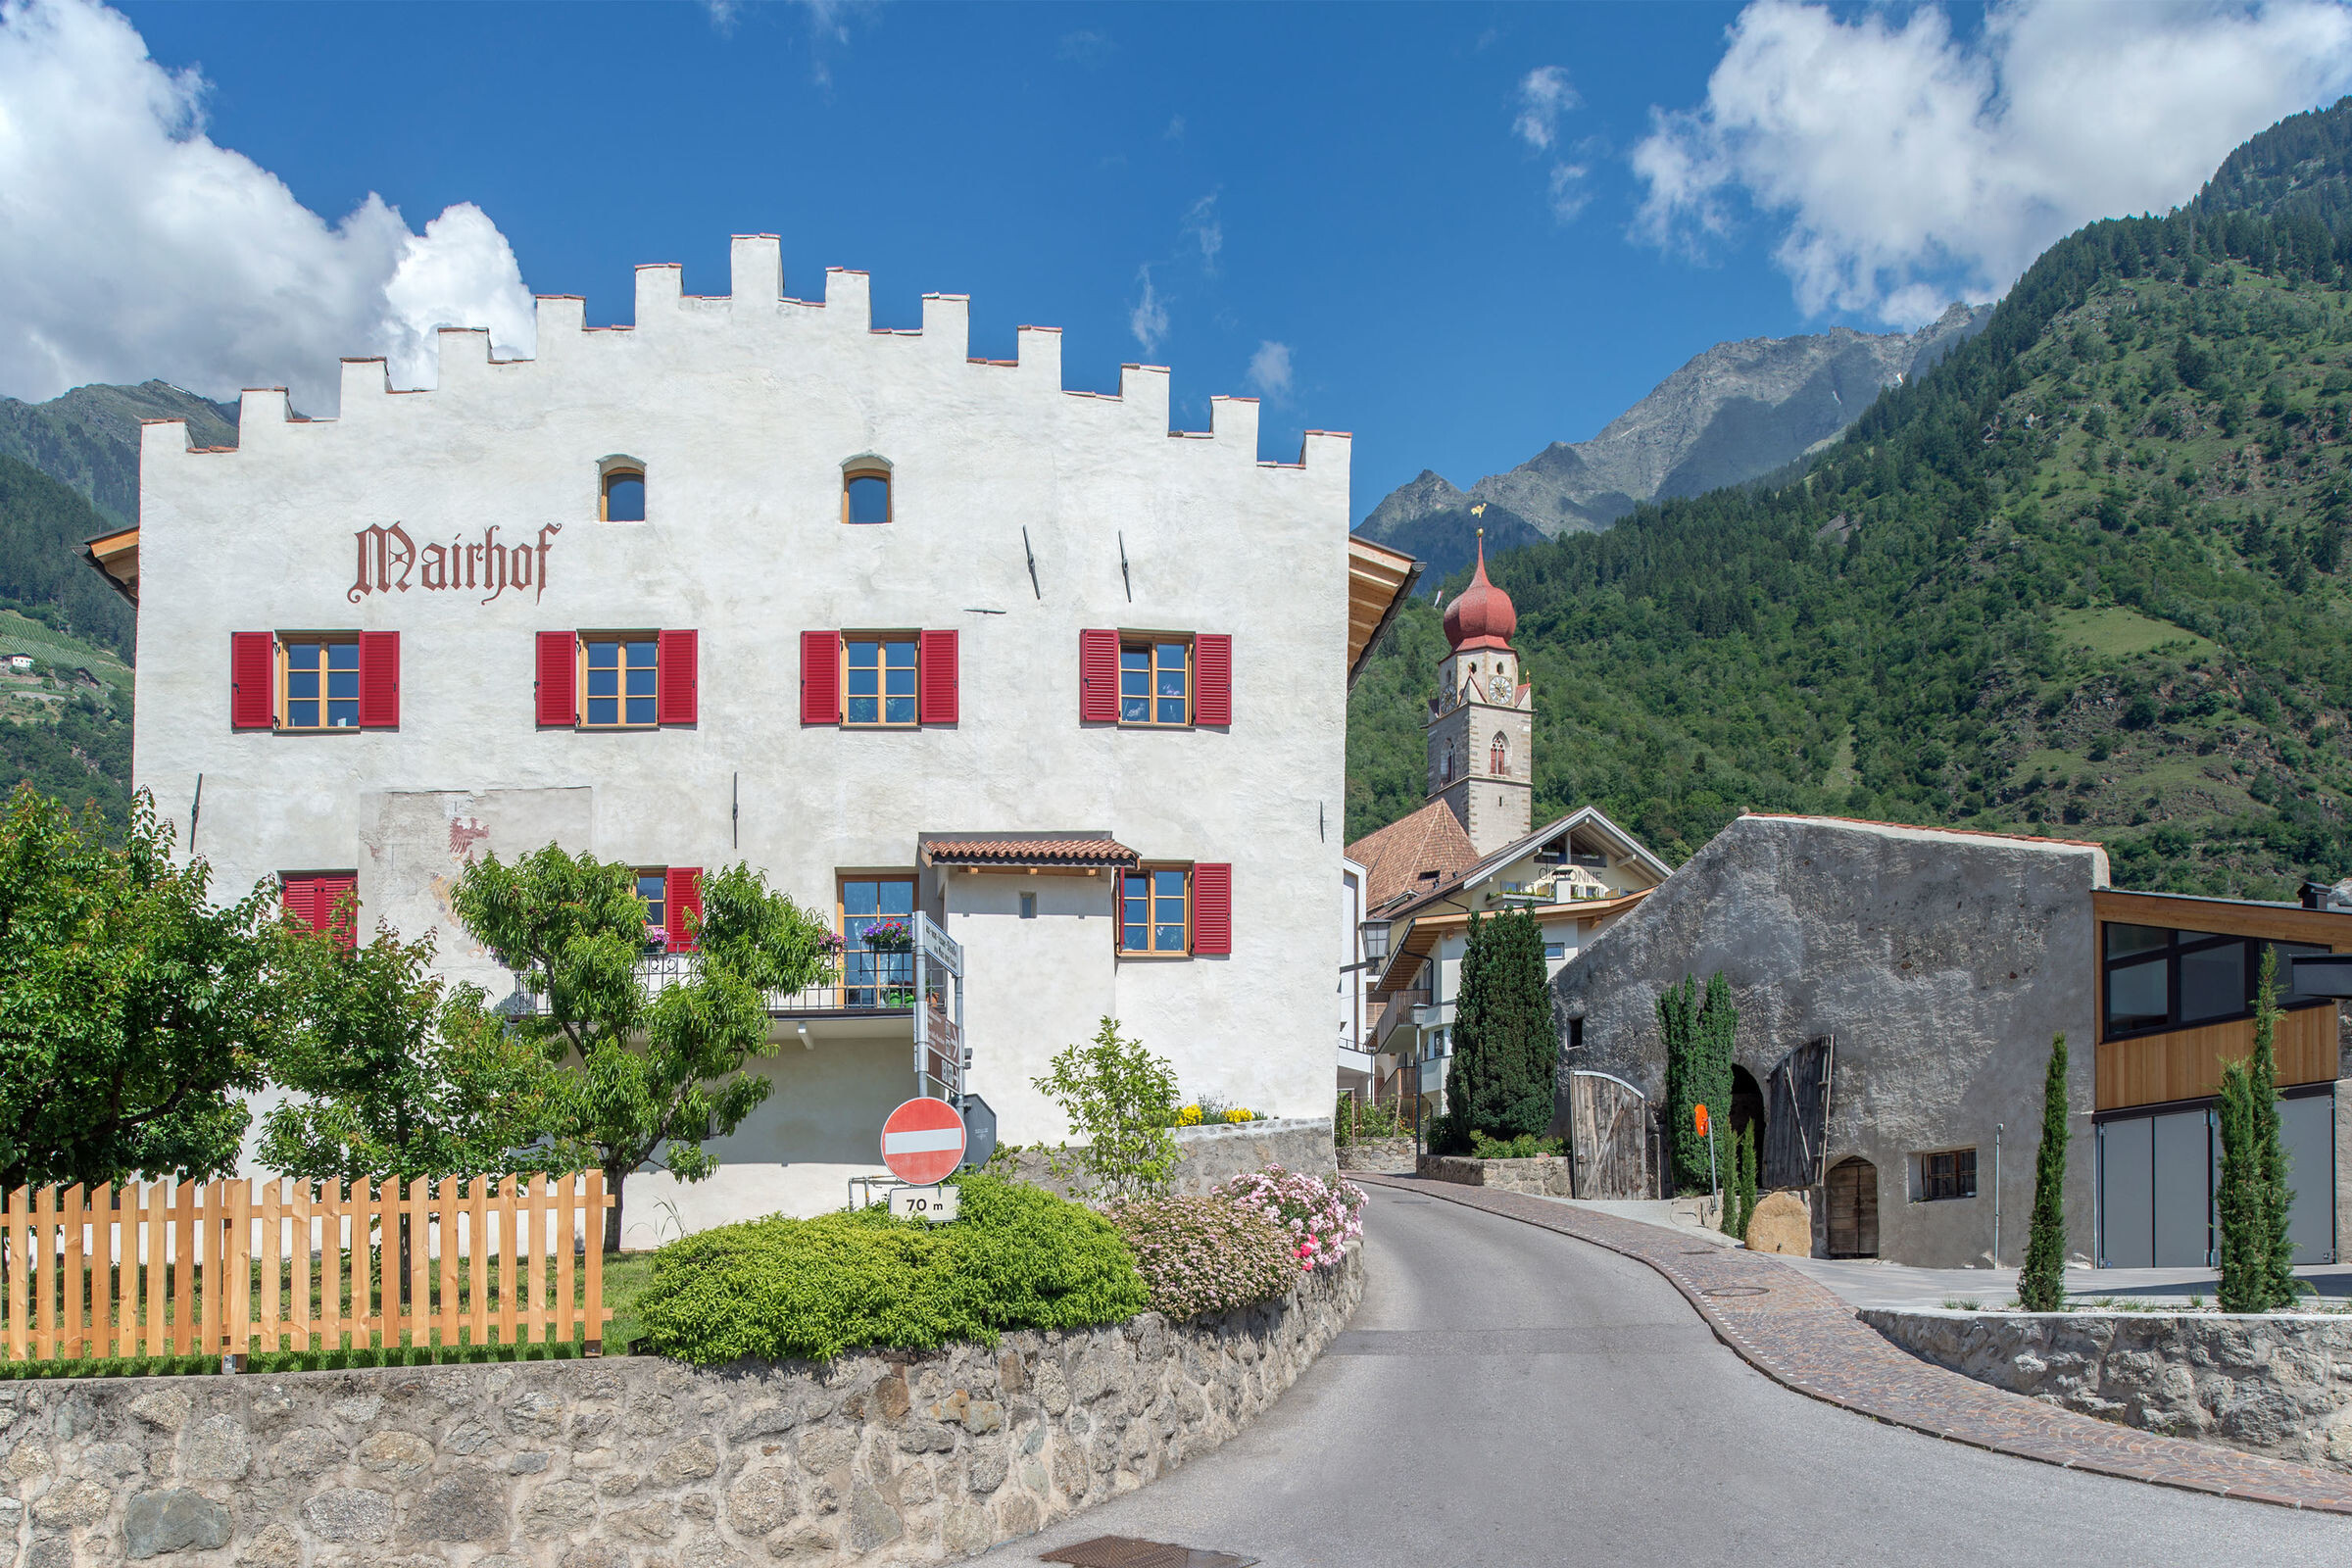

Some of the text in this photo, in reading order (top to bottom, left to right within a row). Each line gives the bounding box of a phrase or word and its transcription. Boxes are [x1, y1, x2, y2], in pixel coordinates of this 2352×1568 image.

[347, 520, 563, 606] Mairhof
[906, 1198, 944, 1212] 70 m
